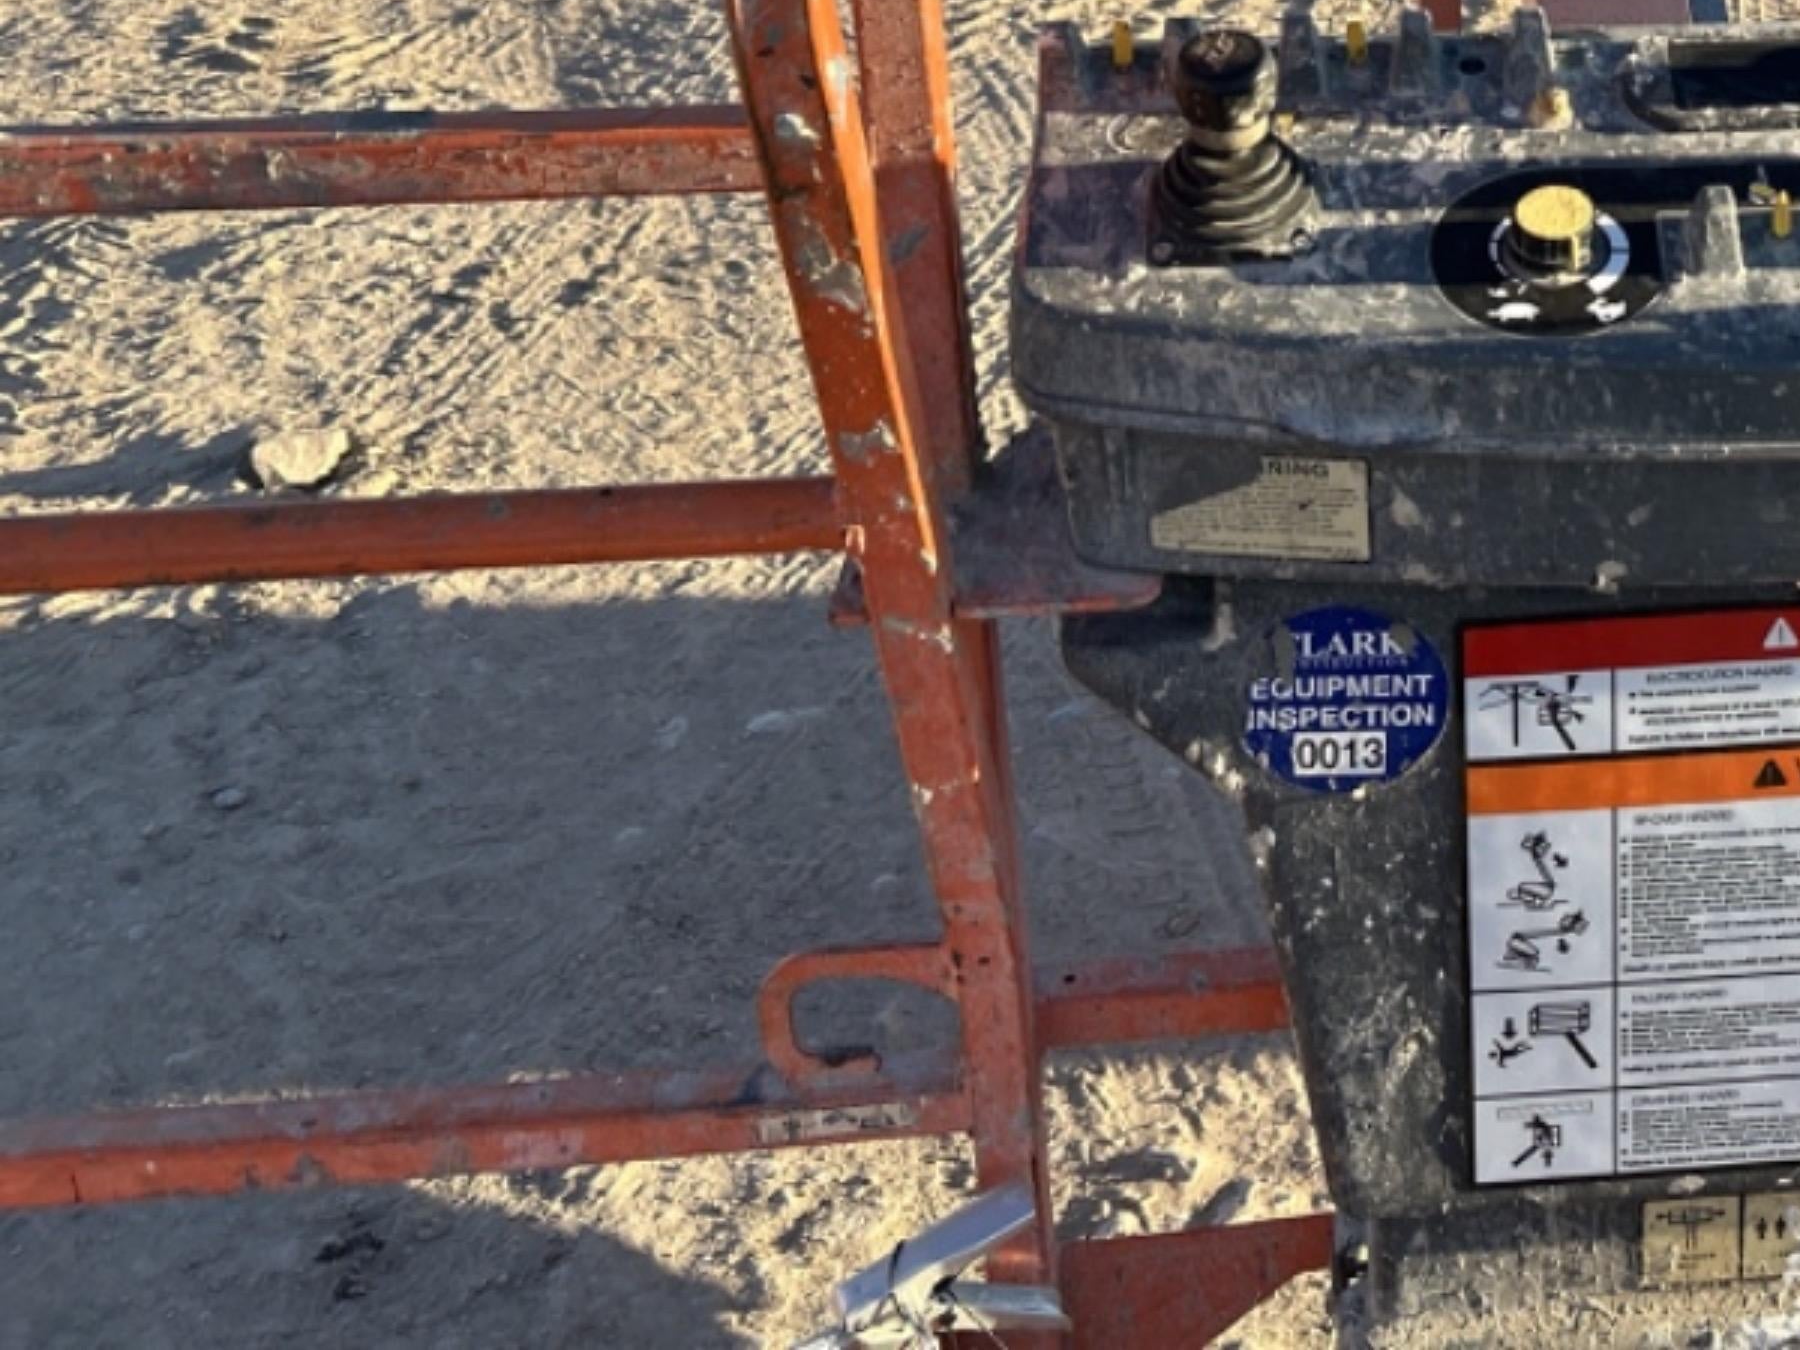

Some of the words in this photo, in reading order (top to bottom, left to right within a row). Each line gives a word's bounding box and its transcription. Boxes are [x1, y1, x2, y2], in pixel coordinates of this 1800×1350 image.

[1292, 630, 1406, 659] LARK
[1251, 673, 1434, 701] EQUIPMENT
[1246, 702, 1436, 732] INSPECTION
[1296, 736, 1385, 771] 0013
